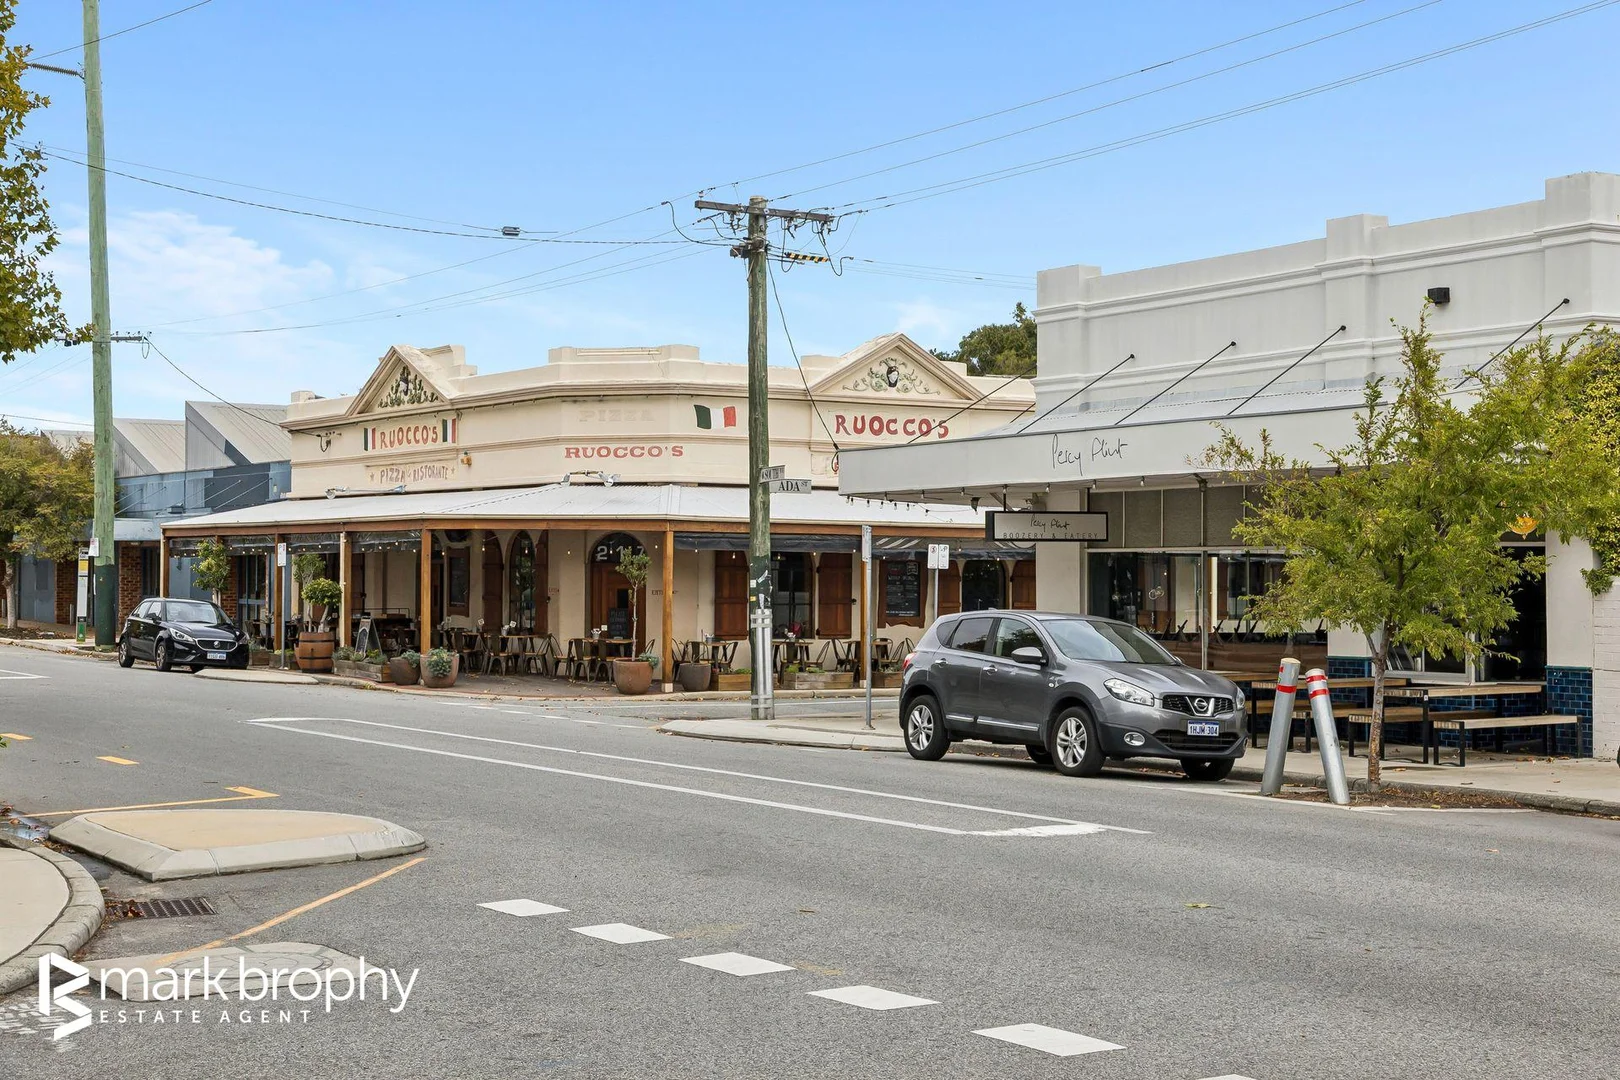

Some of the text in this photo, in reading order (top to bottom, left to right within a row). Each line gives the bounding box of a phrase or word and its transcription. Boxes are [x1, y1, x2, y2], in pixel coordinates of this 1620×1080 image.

[380, 425, 439, 449] RUOCCO'S
[835, 413, 949, 440] RUOCCO'S
[564, 444, 683, 459] RUOCCO'S
[1052, 433, 1084, 477] Percy
[380, 467, 406, 484] PIZZA
[412, 464, 449, 482] RISTORANTE
[777, 480, 800, 492] ADA
